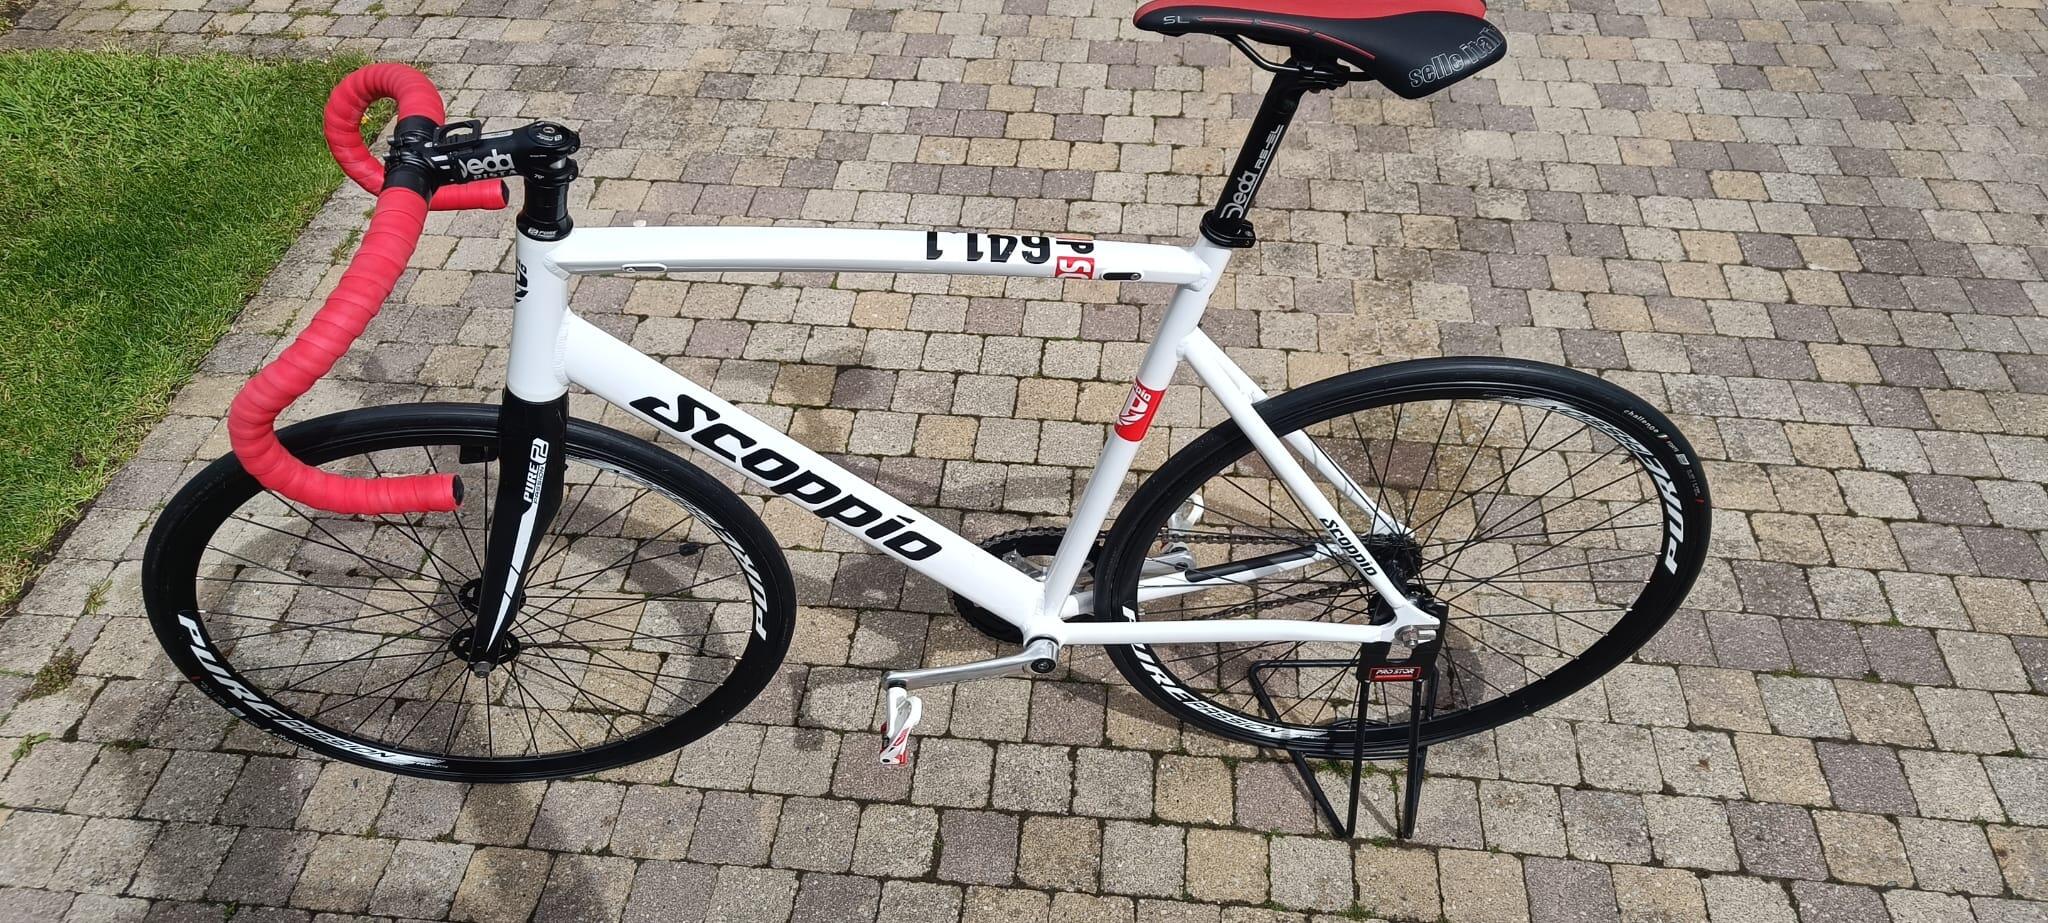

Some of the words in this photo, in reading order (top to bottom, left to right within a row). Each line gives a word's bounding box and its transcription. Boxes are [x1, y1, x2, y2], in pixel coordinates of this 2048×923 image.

[1163, 15, 1190, 25] SL
[1408, 53, 1464, 88] selle
[1220, 170, 1258, 219] Deda
[522, 461, 540, 503] PURE
[629, 394, 943, 561] Scoppio
[1642, 455, 1684, 575] PURE
[1319, 518, 1378, 576] Scoppio
[177, 614, 294, 720] PURE
[1375, 668, 1394, 676] PRO
